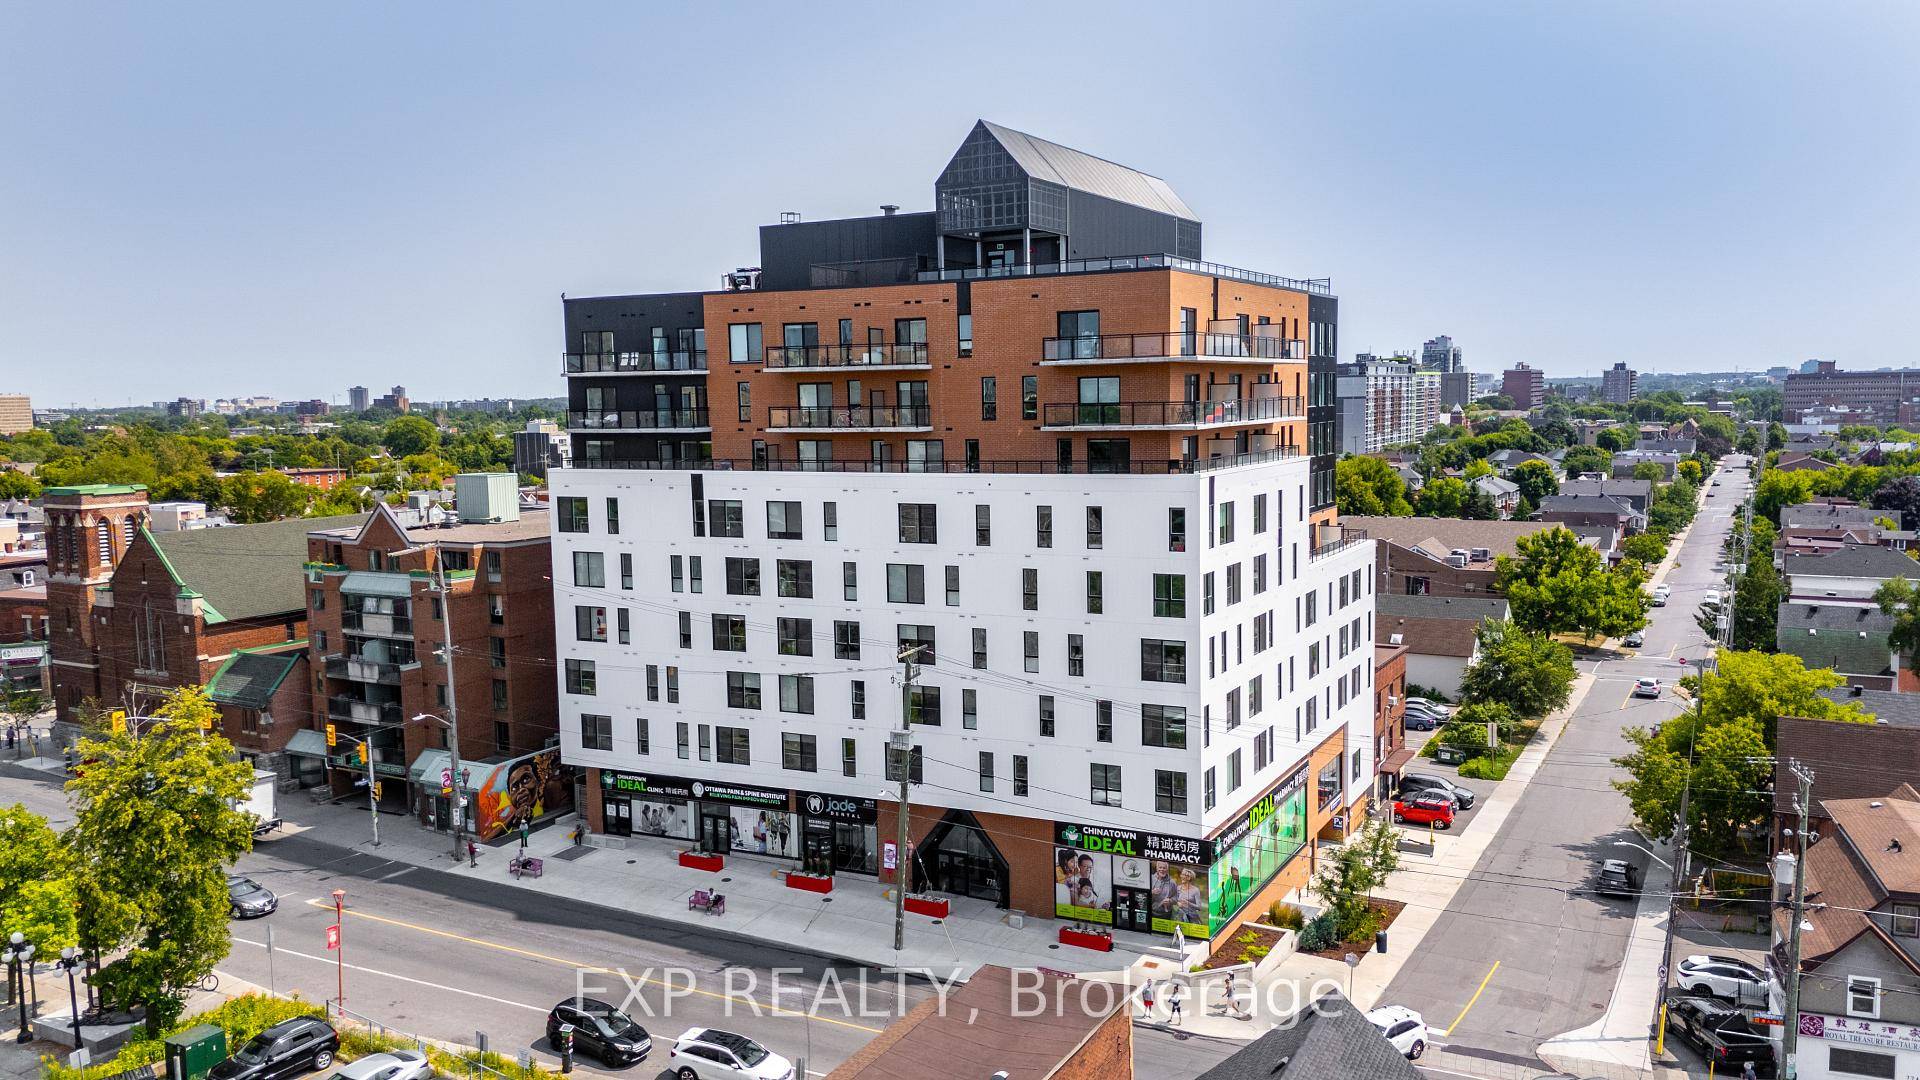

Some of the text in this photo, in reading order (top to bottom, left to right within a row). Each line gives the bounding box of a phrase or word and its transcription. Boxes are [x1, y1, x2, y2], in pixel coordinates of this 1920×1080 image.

[617, 774, 647, 783] CHINATOWN
[617, 779, 664, 794] IDEAL CLINIC
[704, 786, 727, 794] OTTAWA
[727, 788, 741, 796] PAIN
[744, 790, 760, 798] SPINE
[760, 792, 786, 801] INSTITUTE
[826, 797, 857, 813] jade
[830, 811, 861, 819] DENTAL
[1223, 818, 1250, 848] CHINATOWN
[1249, 793, 1275, 831] IDEAL
[1274, 779, 1296, 804] PHARMACY
[1082, 826, 1137, 840] CHINATOWN
[1083, 835, 1137, 855] IDEAL
[1146, 835, 1200, 854] 精诚药房
[1144, 849, 1201, 864] PHARMACY
[1824, 1031, 1847, 1041] ROYAL
[1849, 1034, 1883, 1045] TREASURE
[1886, 1040, 1920, 1050] RESTAUR
